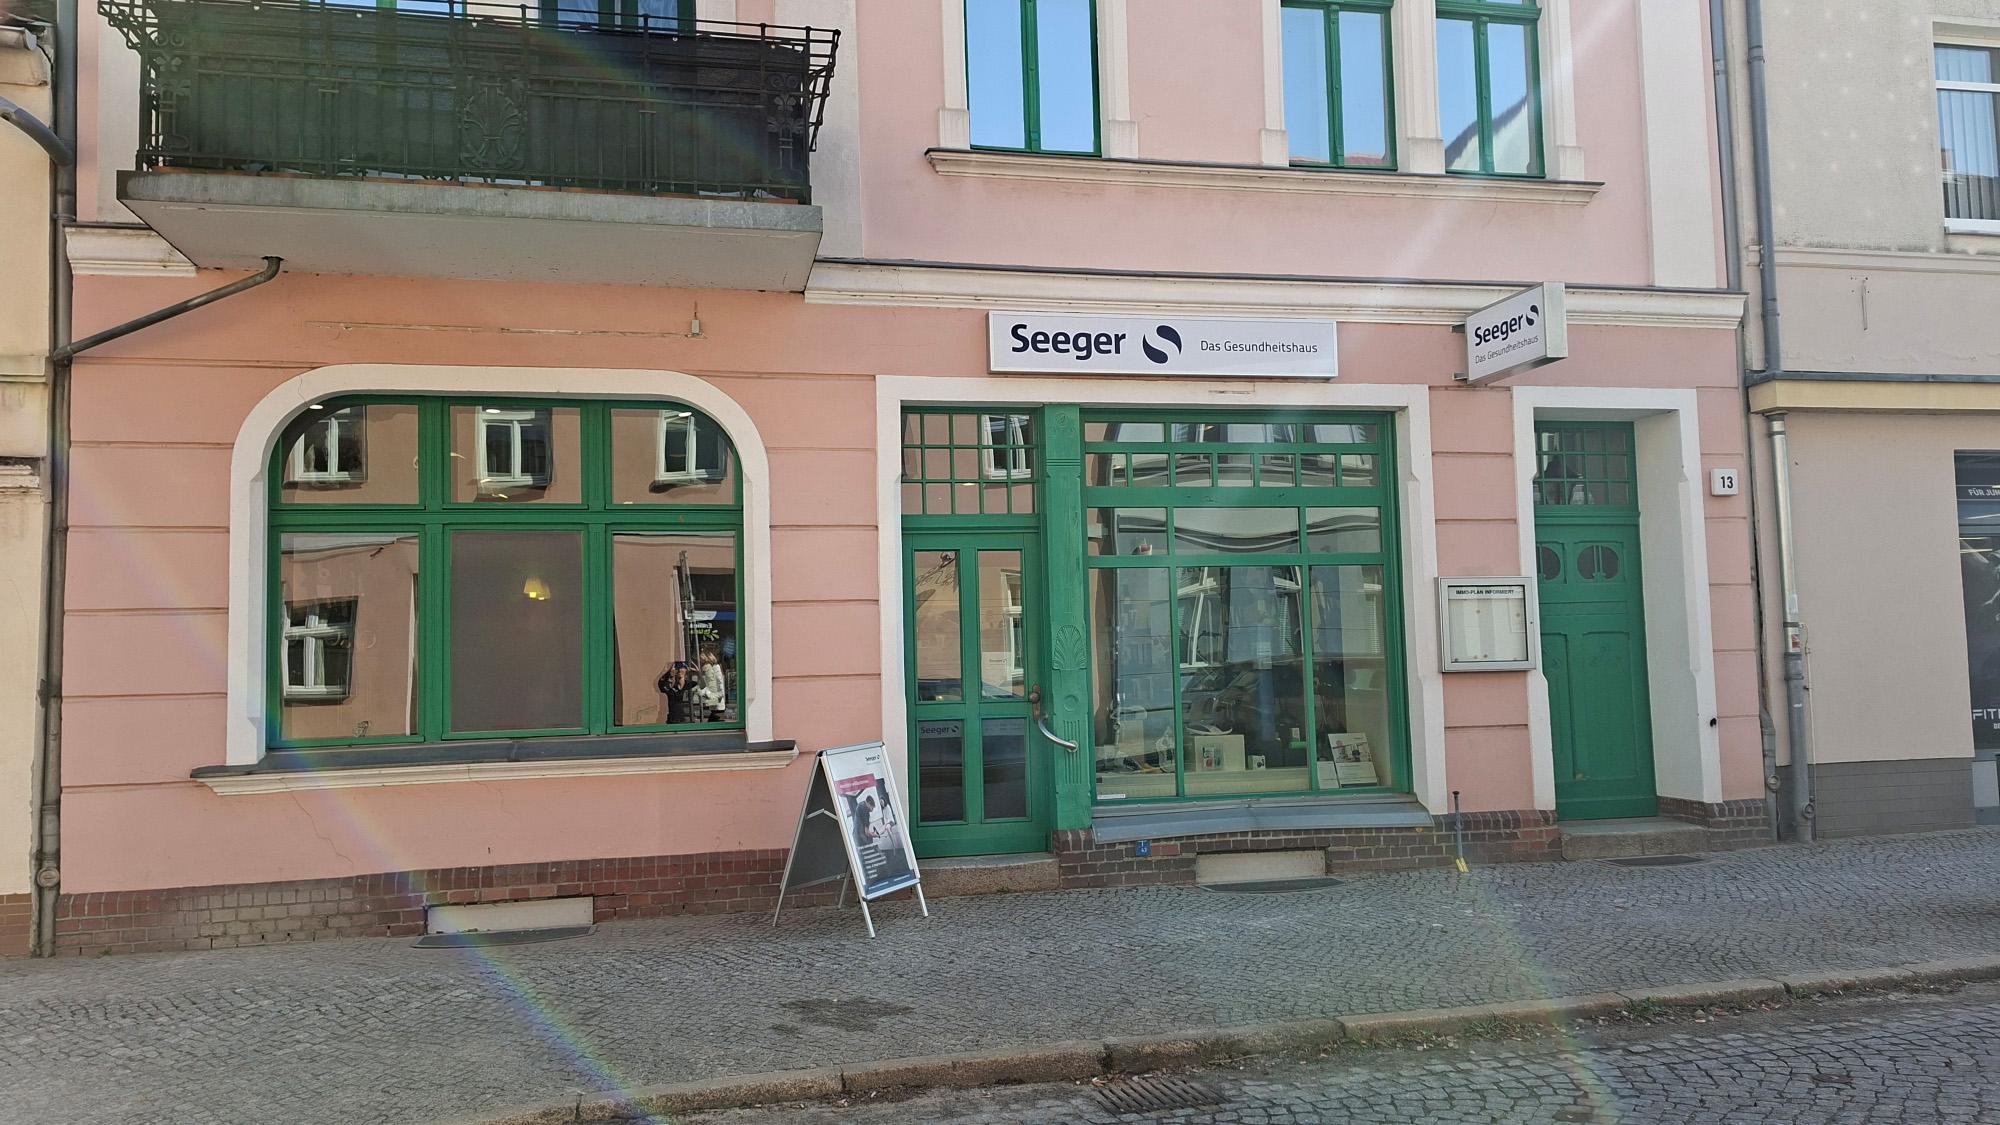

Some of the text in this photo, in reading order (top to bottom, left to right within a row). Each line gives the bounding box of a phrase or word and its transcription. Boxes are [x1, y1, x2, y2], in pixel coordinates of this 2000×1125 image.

[1475, 314, 1524, 347] Seeger
[1010, 323, 1126, 361] Seeger
[1200, 340, 1318, 353] Das Gesundheitshaus
[1475, 335, 1539, 364] Das Gesundheitshaus
[1720, 475, 1734, 489] 13
[1967, 487, 1985, 496] FÜR
[920, 726, 950, 735] Seeger
